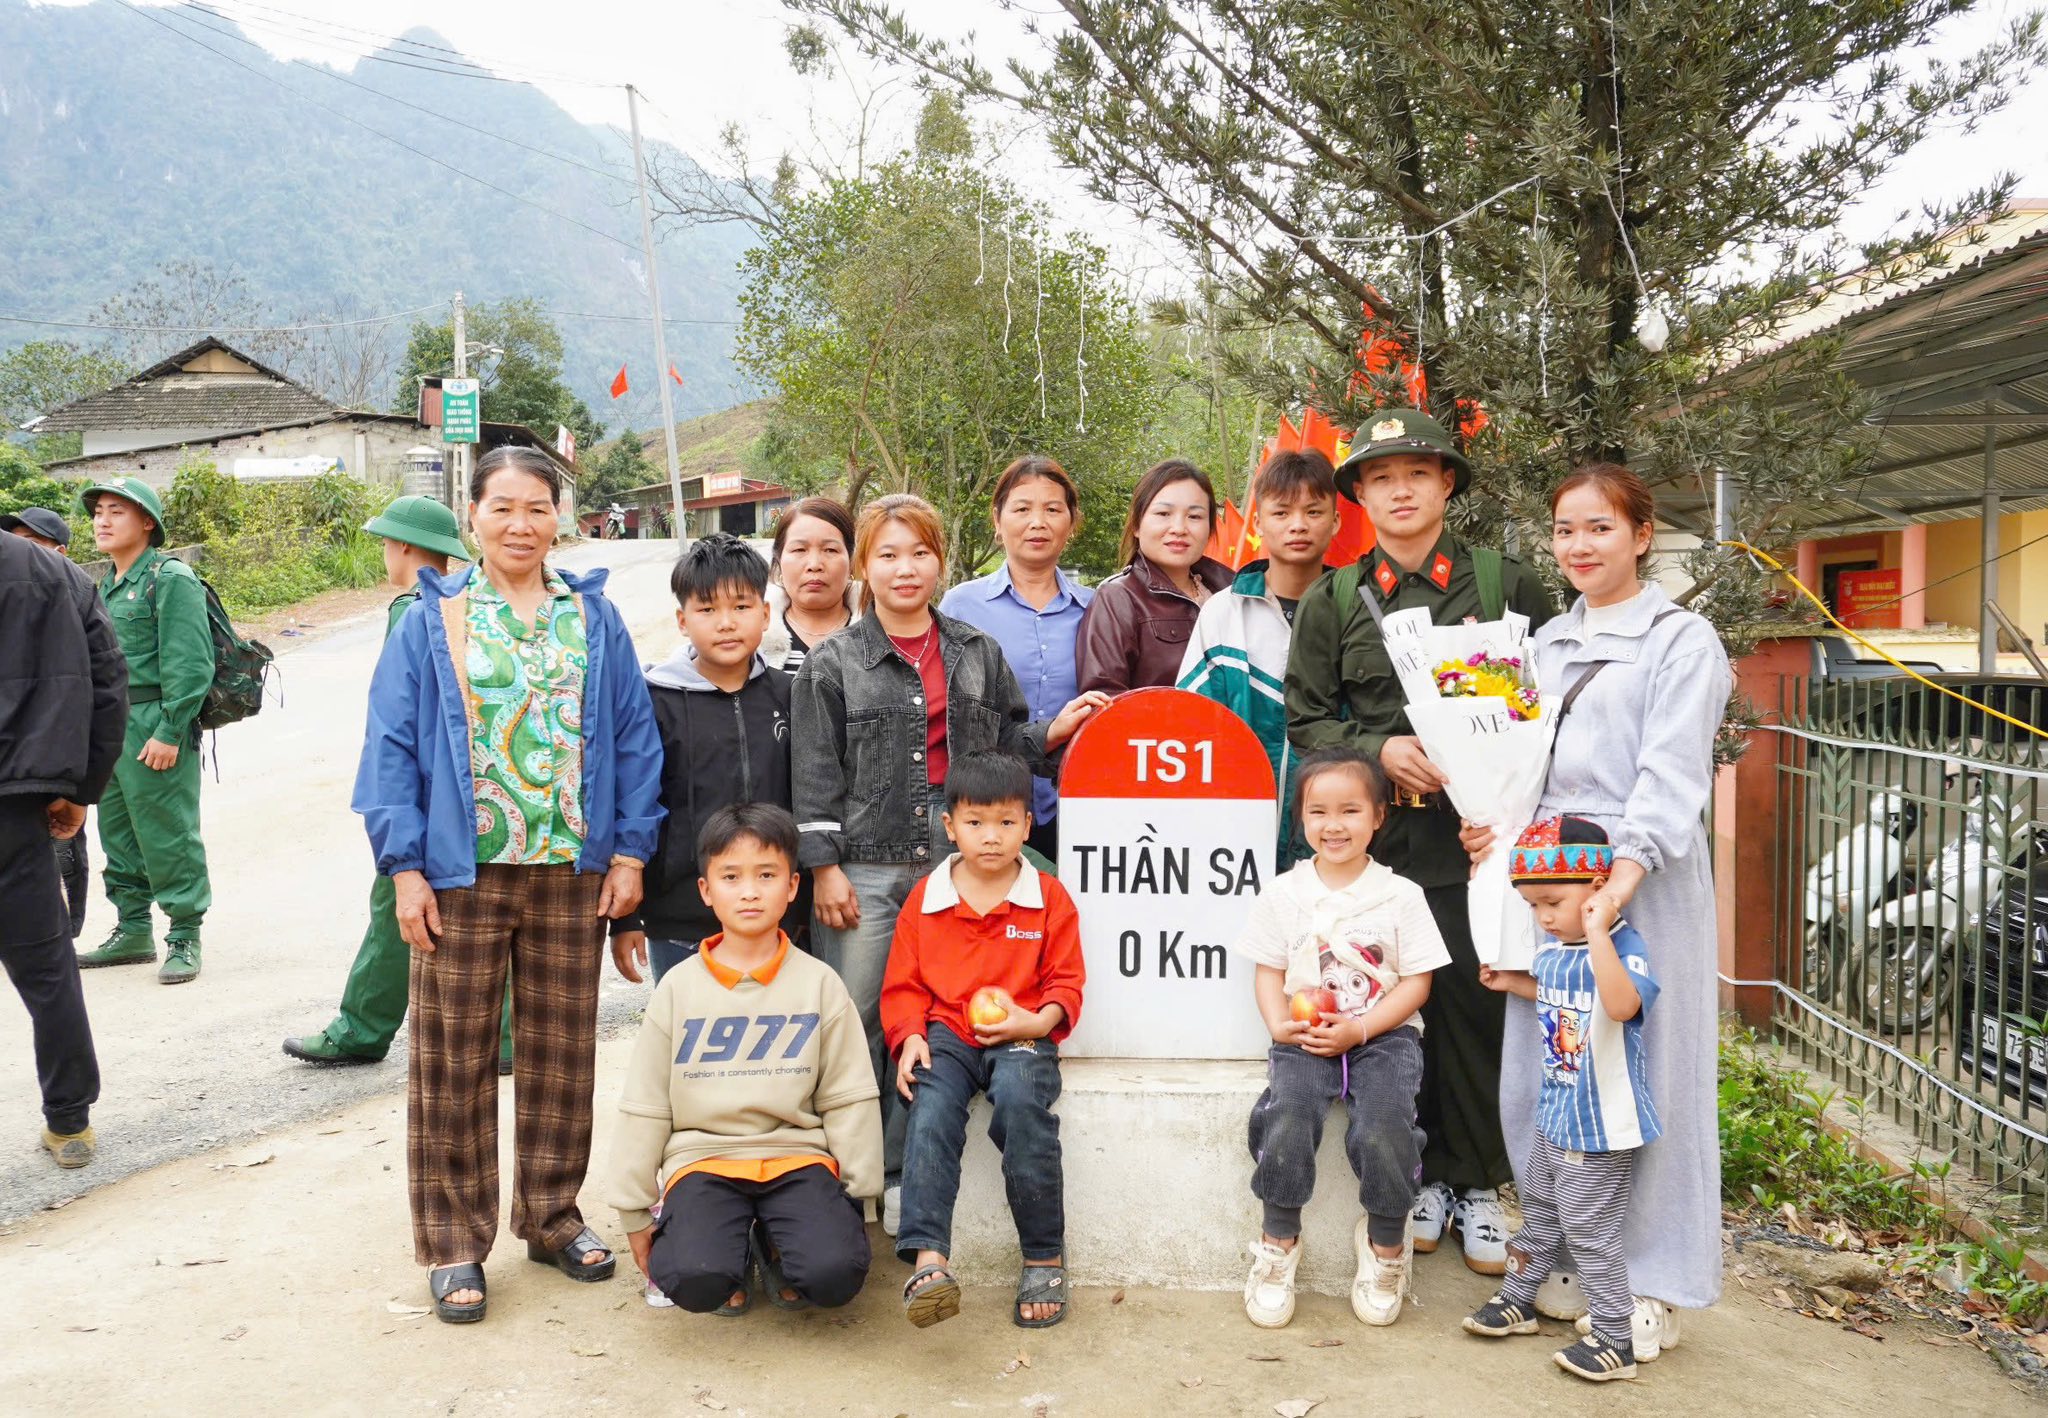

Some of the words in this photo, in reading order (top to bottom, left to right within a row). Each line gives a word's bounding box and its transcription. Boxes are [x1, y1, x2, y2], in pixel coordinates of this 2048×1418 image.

[1072, 823, 1190, 894] THẦN
[1208, 847, 1262, 896] SA
[1119, 929, 1141, 978] 0
[1159, 930, 1227, 979] Km
[674, 1013, 820, 1064] 1977
[683, 1070, 715, 1079] Fashion
[728, 1067, 772, 1077] constantly
[775, 1066, 811, 1075] changing
